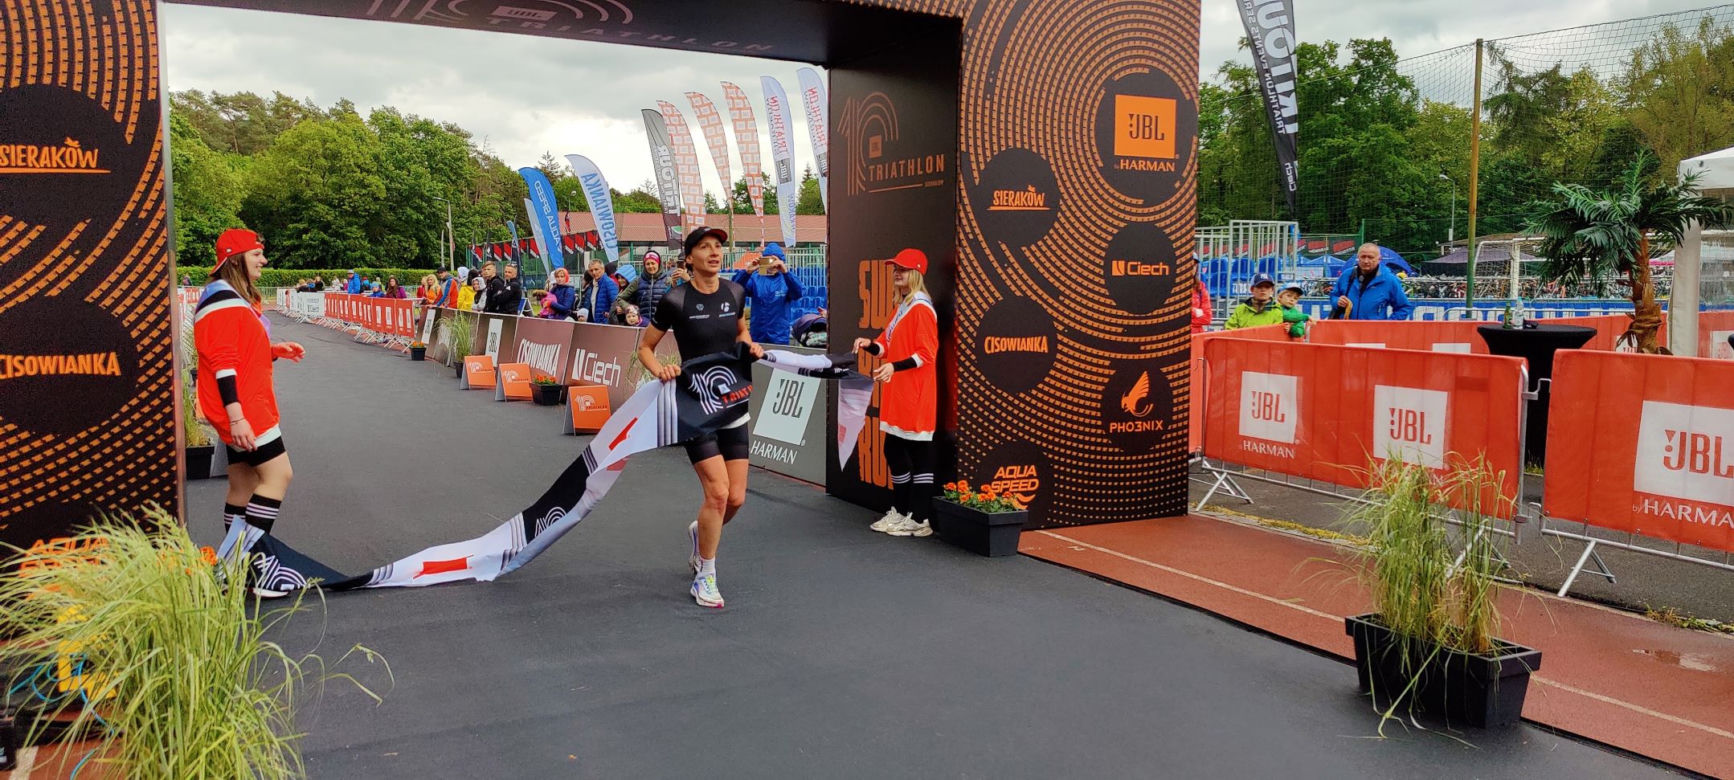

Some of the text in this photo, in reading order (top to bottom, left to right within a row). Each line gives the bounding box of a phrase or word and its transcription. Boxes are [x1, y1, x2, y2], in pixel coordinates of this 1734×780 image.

[485, 16, 773, 51] TRIATHLON
[1128, 113, 1165, 141] JBL
[868, 153, 945, 182] TRIATHLON
[1120, 158, 1176, 172] HARMAN
[1126, 261, 1170, 277] Ciech
[984, 335, 1049, 355] CISOWIANKA
[584, 352, 622, 388] Ciech
[772, 378, 805, 419] JBL
[1251, 390, 1286, 423] JBL
[1389, 407, 1432, 445] JBL
[750, 440, 798, 465] HARMAN
[1243, 439, 1295, 459] HARMAN
[1663, 429, 1734, 479] JBL
[991, 478, 1040, 493] SPEED
[993, 464, 1038, 479] AQUA
[1632, 498, 1734, 530] by HARMA
